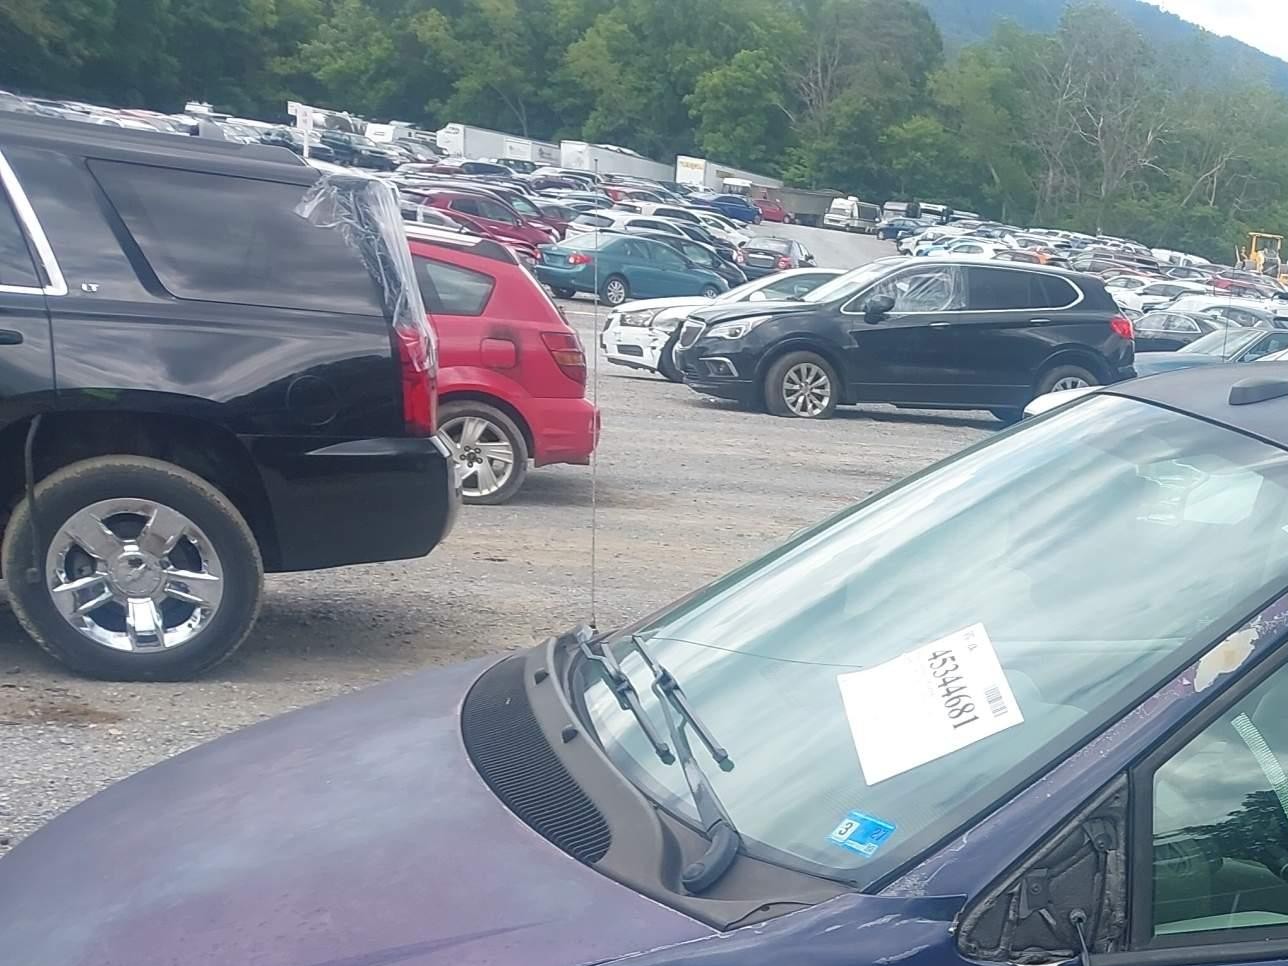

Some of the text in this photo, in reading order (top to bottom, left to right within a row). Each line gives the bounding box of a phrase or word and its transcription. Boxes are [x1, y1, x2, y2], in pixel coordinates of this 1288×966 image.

[81, 283, 100, 293] LT
[927, 649, 980, 730] 45344681
[838, 822, 854, 836] 3
